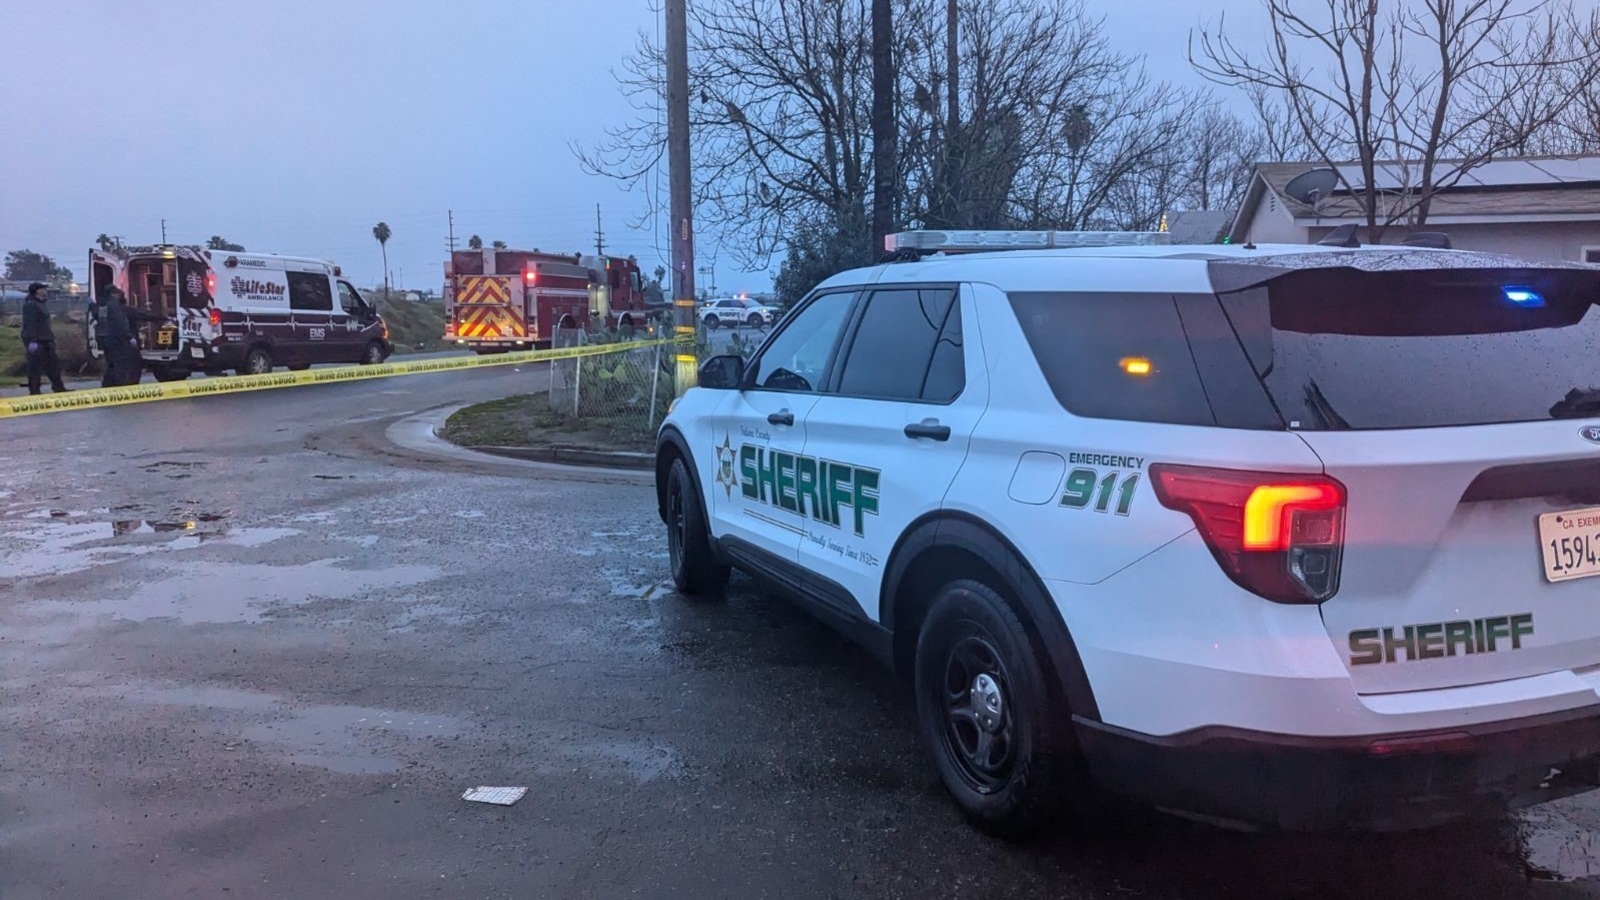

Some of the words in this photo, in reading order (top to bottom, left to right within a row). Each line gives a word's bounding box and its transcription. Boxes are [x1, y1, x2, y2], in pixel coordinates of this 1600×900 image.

[246, 280, 285, 295] LifeStar
[247, 294, 284, 302] AMBULANCE
[310, 328, 325, 338] EMS
[1069, 452, 1144, 469] EMERGENCY
[740, 442, 882, 538] SHERIFF
[1058, 467, 1142, 517] 911
[1563, 519, 1574, 530] CA
[845, 545, 858, 560] Since
[1347, 612, 1535, 666] SHERIFF
